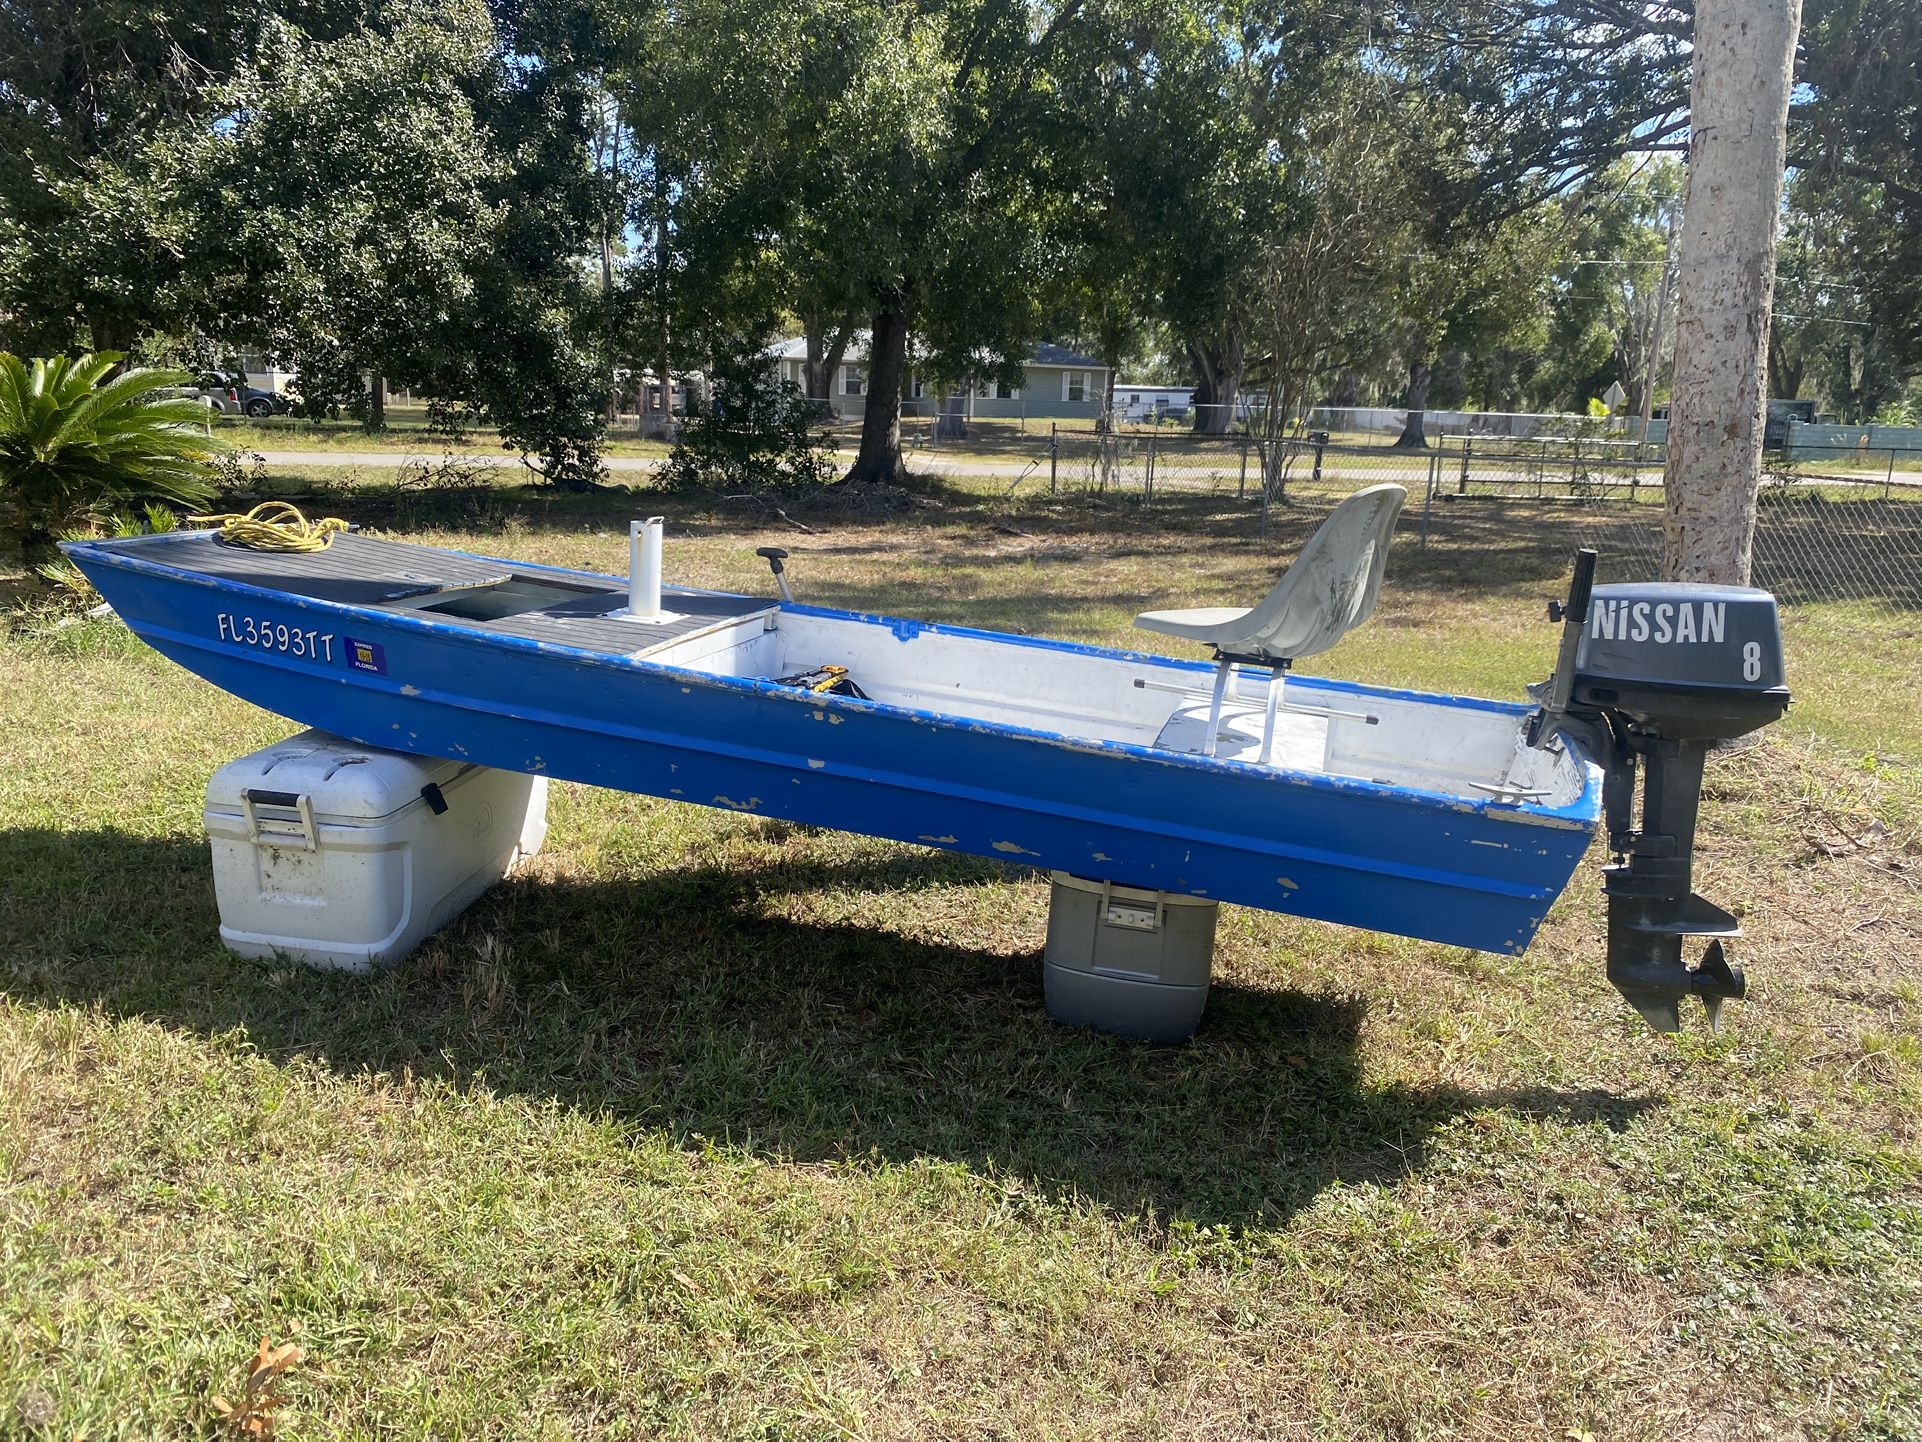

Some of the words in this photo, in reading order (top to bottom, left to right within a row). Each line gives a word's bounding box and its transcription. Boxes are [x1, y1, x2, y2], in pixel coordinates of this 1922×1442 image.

[217, 613, 334, 661] FL3593TT
[1591, 600, 1726, 643] NISSAN
[355, 661, 378, 671] FLORIDA
[1743, 641, 1761, 682] 8
